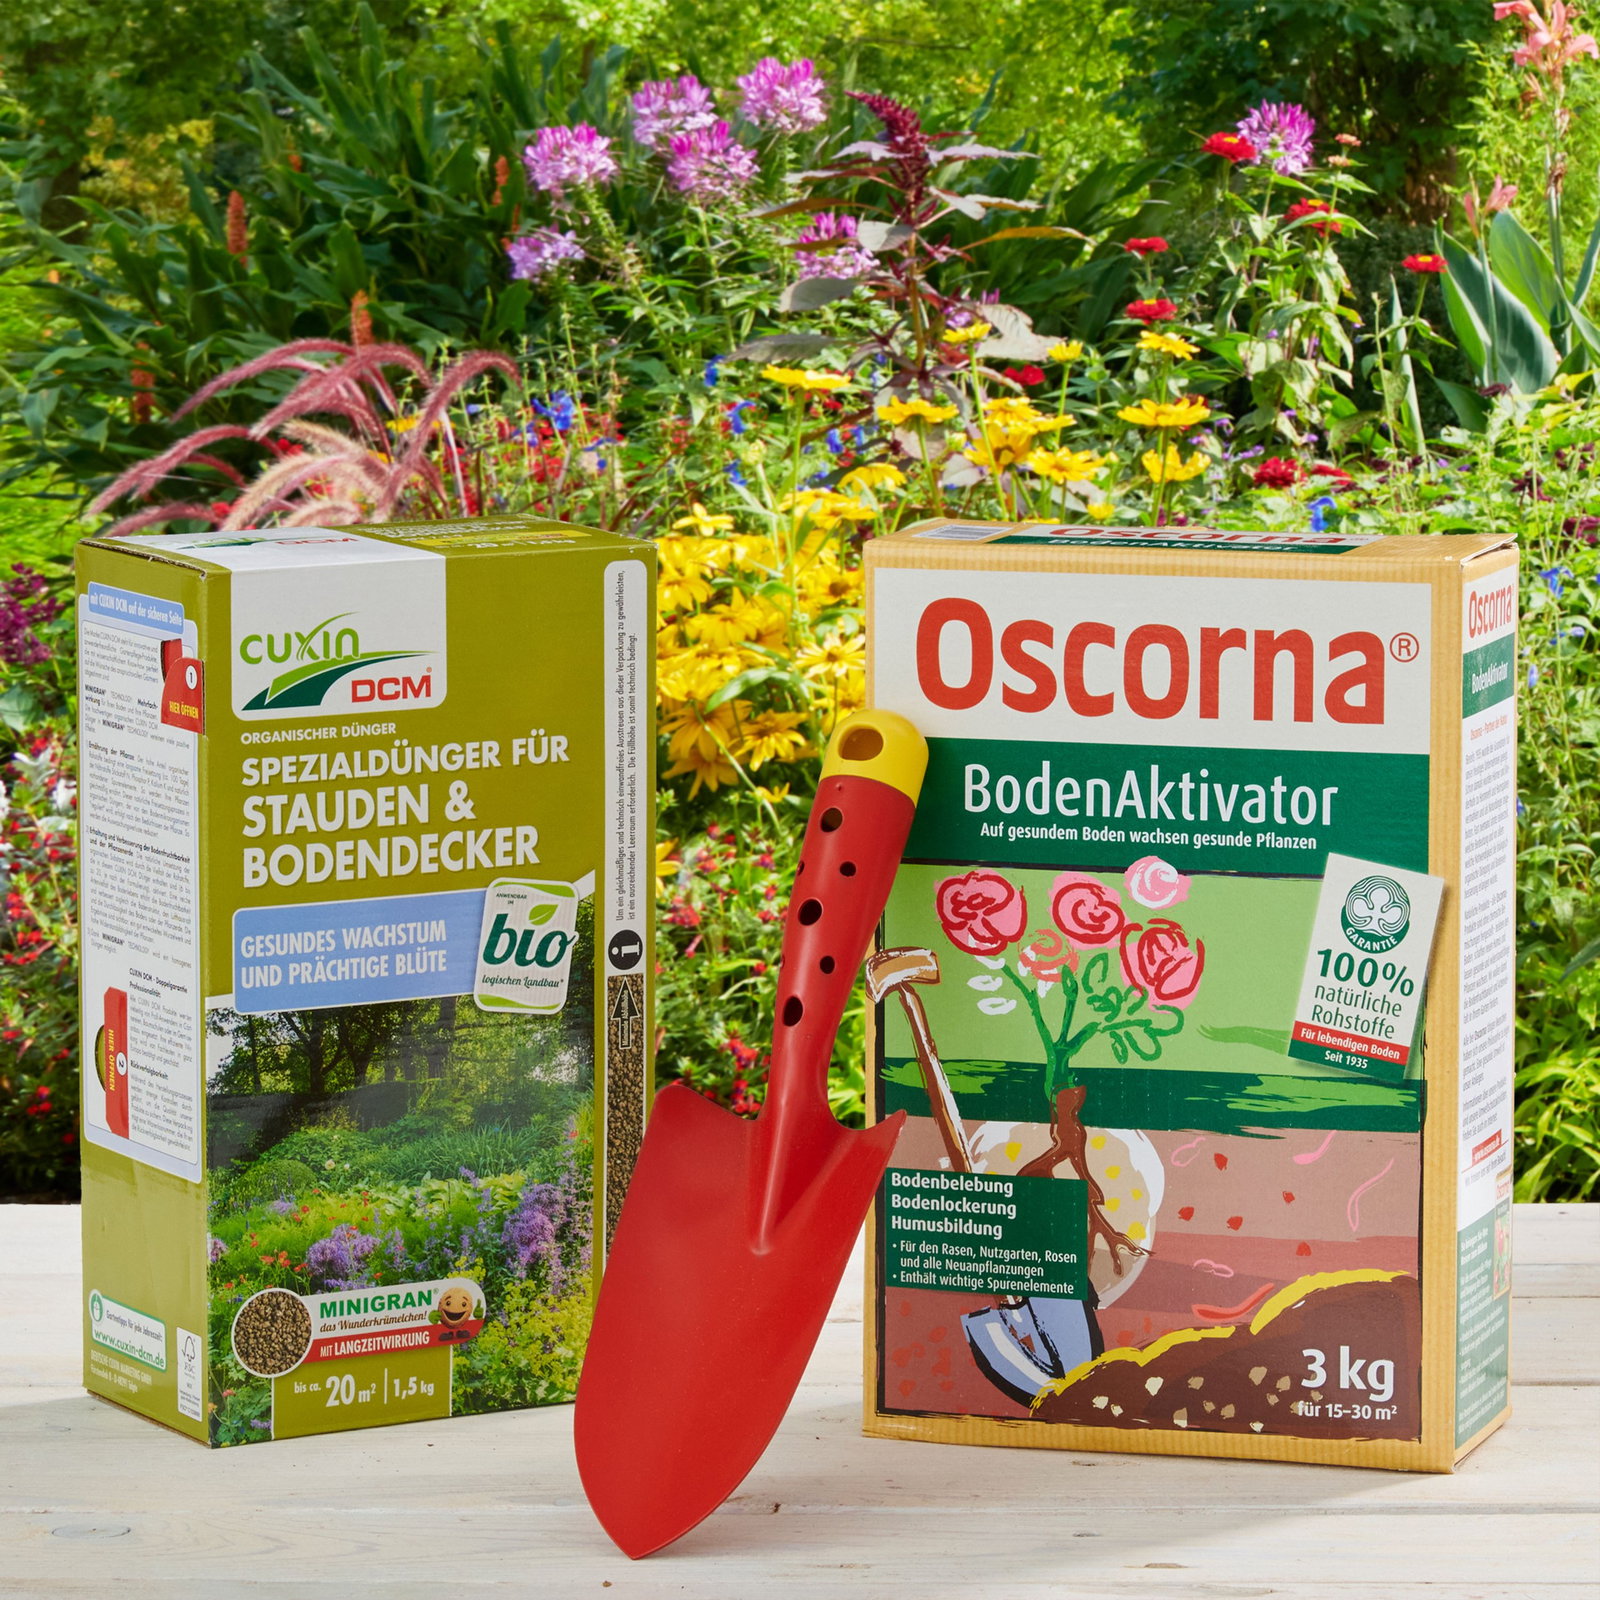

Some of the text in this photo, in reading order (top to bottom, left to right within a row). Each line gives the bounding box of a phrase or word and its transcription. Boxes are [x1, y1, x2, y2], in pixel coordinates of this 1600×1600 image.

[1049, 528, 1346, 543] Oscorna
[1049, 538, 1297, 552] BodenAktivator
[116, 596, 127, 613] DCM
[615, 570, 626, 620] gewährleisten,
[1469, 585, 1512, 639] Oscorna
[617, 622, 624, 630] zu
[615, 632, 626, 673] Verpackung
[616, 675, 624, 695] dieser
[169, 701, 180, 714] HIER
[181, 702, 199, 719] ÖFFNEN
[241, 722, 396, 745] ORGANISCHER DÜNGER
[616, 710, 624, 748] Ausstreuen
[242, 727, 570, 787] SPEZIALDÜNGER FÜR
[616, 750, 625, 797] einwandfreies
[627, 633, 638, 920] ist ein ausreichender Leerraum erforderlich. Die Füllhöhe ist somit technisch bedingt.
[964, 760, 1338, 826] BodenAktivator
[242, 783, 429, 838] STAUDEN
[444, 779, 476, 823] &
[616, 799, 624, 829] technisch
[616, 832, 624, 844] und
[980, 822, 1317, 850] Auf gesundem Boden wachsen gesunde Pflanzen
[243, 825, 540, 888] BODENDECKER
[615, 846, 626, 895] gleichmäßiges
[495, 891, 527, 900] ANWENDBAR
[616, 896, 624, 907] ein
[616, 909, 624, 921] Um
[240, 919, 447, 959] GESUNDES WACHSTUM
[482, 912, 576, 969] bio
[1345, 926, 1398, 951] GARANTIE
[241, 946, 447, 989] UND PRÄCHTIGE BLÜTE
[1317, 948, 1414, 997] 100%
[482, 974, 522, 988] logischen
[1314, 984, 1401, 1018] natürliche
[1311, 1004, 1395, 1039] Rohstoffe
[1300, 1027, 1401, 1059] Für lebendigen Boden
[1324, 1050, 1368, 1069] Seit 1935
[108, 1054, 116, 1092] ÖFFNEN
[891, 1172, 1014, 1198] Bodenbelebung
[891, 1193, 1017, 1219] Bodenlockerung
[891, 1215, 1003, 1240] Humusbildung
[900, 1240, 1077, 1264] Für den Rasen, Nutzgarten, Rosen
[900, 1257, 1044, 1279] und alle Neuanpflanzungen
[900, 1271, 1074, 1294] Enthält wichtige Spurenelemente
[106, 1309, 126, 1329] Gartentipps
[320, 1310, 427, 1333] das Wunderkrümelchen!
[94, 1329, 165, 1367] www.cuxin-dcm.de
[320, 1332, 430, 1357] MIT LANGZEITWIRKUNG
[1301, 1345, 1395, 1402] 3 kg
[294, 1374, 376, 1408] bis ca. 20 m²
[393, 1377, 434, 1400] 1,5 kg
[1297, 1400, 1321, 1417] für
[1376, 1405, 1398, 1420] m²
